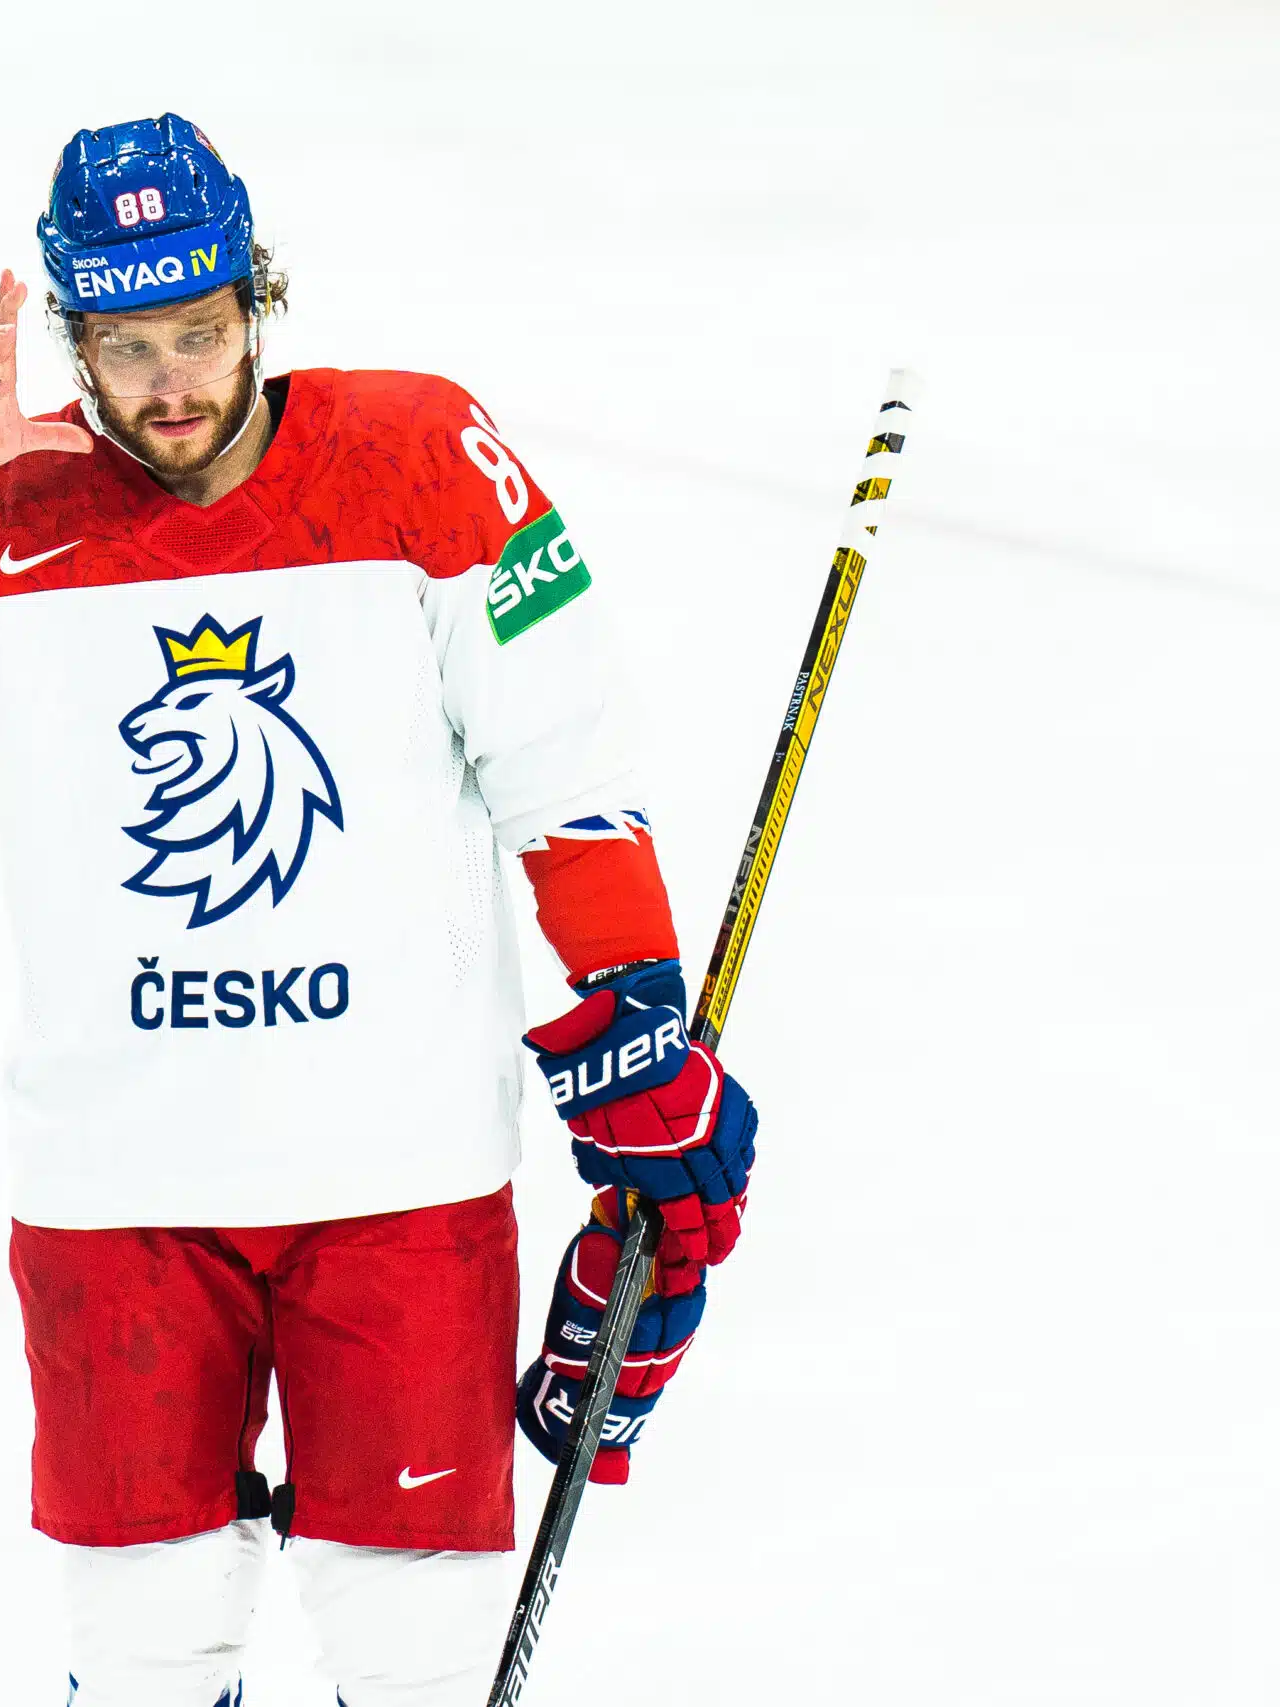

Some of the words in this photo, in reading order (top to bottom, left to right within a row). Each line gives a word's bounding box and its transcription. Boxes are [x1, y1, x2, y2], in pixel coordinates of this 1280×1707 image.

[115, 187, 165, 228] 88
[72, 256, 109, 270] ŠKODA
[74, 256, 184, 298] ENYAQ
[190, 244, 218, 276] iV
[460, 403, 528, 524] 8
[808, 548, 866, 712] NEXUS
[131, 956, 349, 1030] ČESKO
